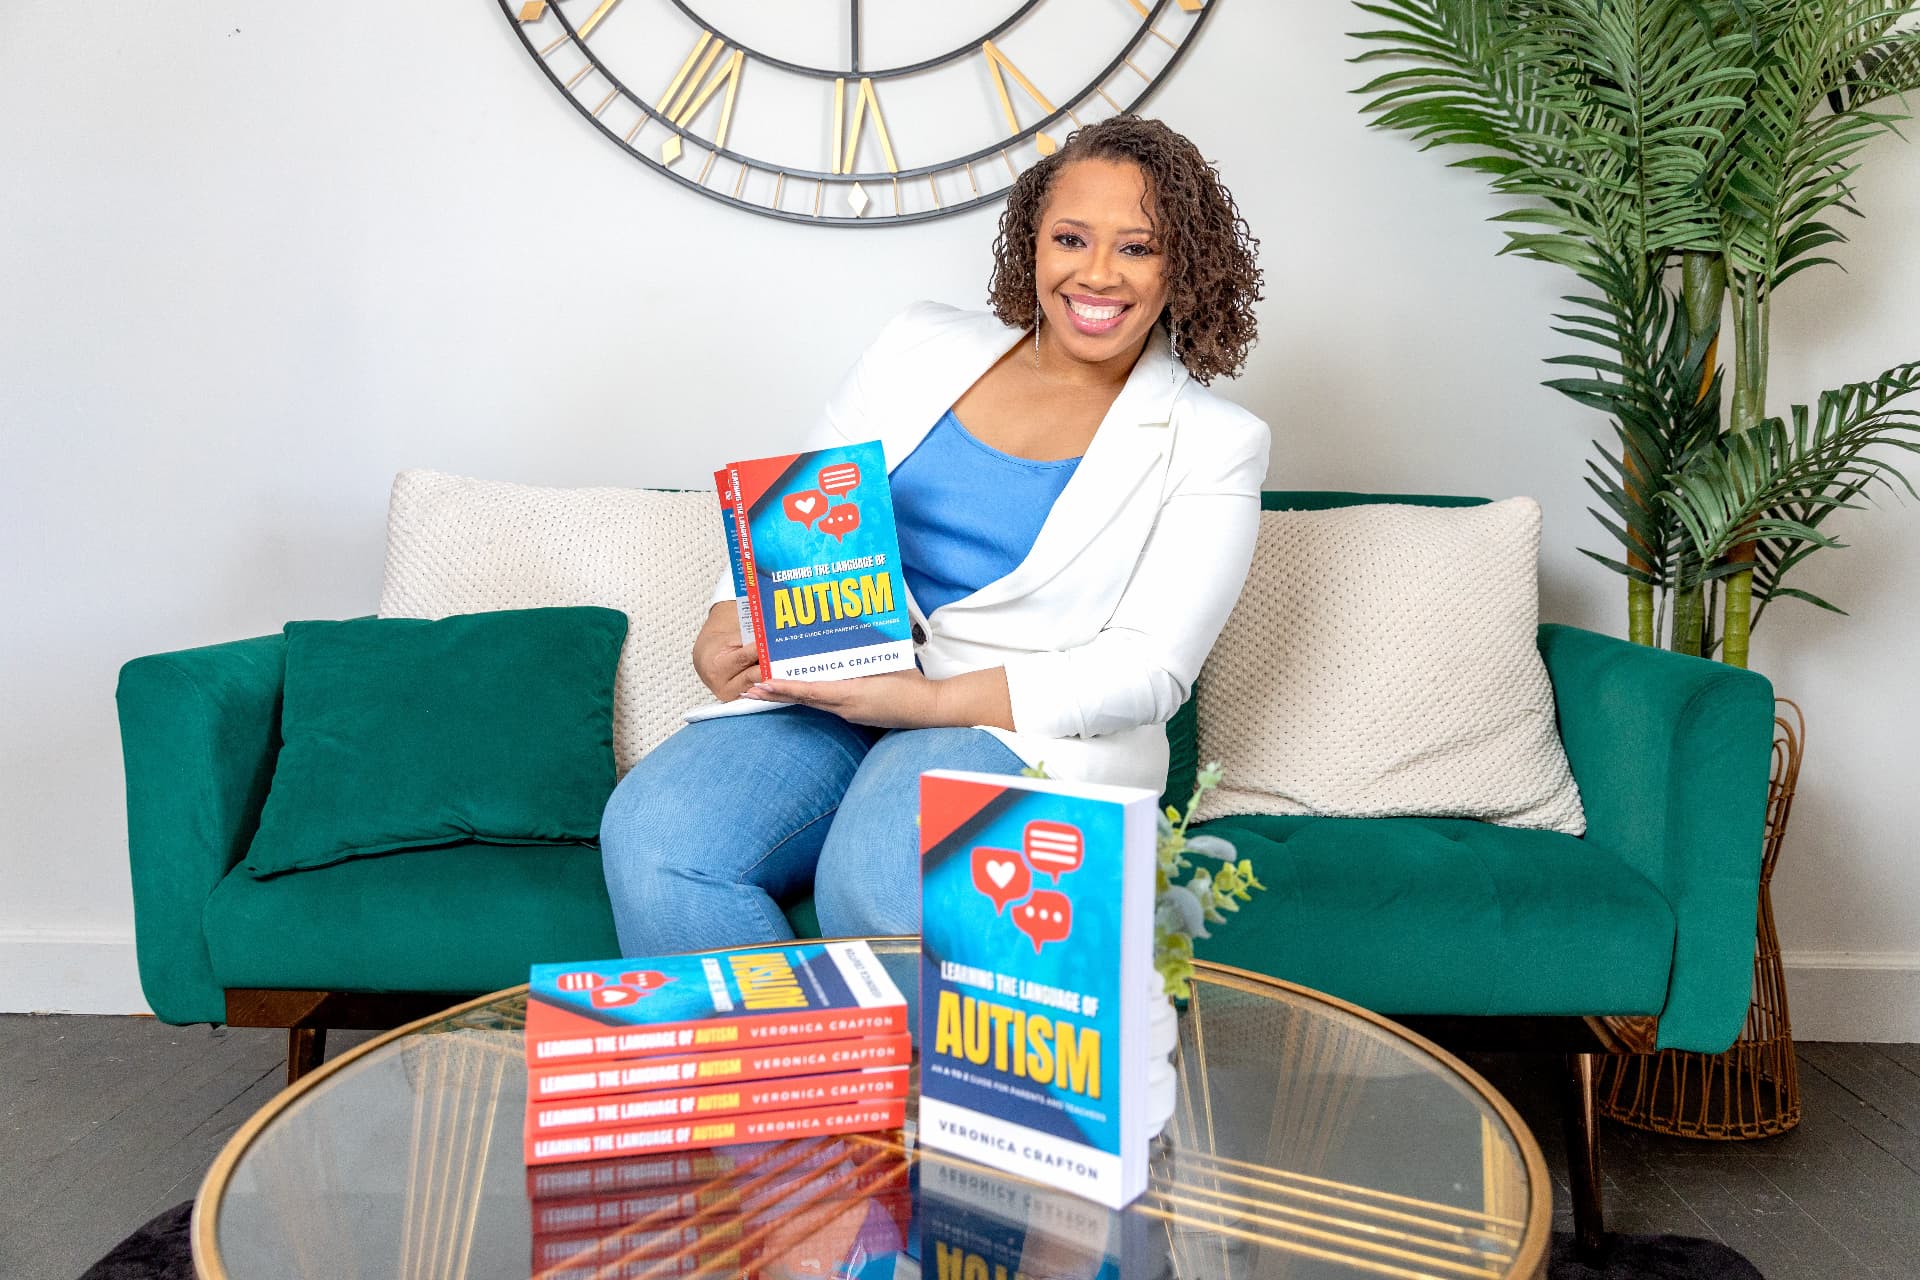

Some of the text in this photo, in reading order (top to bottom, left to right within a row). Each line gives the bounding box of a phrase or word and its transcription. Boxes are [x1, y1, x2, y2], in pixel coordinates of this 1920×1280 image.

[772, 554, 886, 582] LEARNING THE LANGUAGE OF
[774, 572, 895, 630] AUTISM
[804, 630, 821, 638] GUIDE
[834, 624, 859, 634] PARENTS
[859, 622, 872, 630] AND
[872, 618, 900, 627] TEACHERS
[786, 652, 899, 677] VERONICA CRAFTON
[728, 952, 809, 1010] AUTISM
[941, 960, 1099, 1018] LEARNING THE LANGUAGE OF
[537, 1016, 893, 1058] LEARNING THE LANGUAGE OF AUTISM VERONICA CRAFTON
[935, 989, 1101, 1099] AUTISM
[540, 1047, 896, 1094] LEARNING THE LANGUAGE OF AUTISM VERONICA CRAFTON
[539, 1081, 894, 1128] LEARNING THE LANGUAGE OF AUTISM VERONICA CRAFTON
[534, 1112, 890, 1158] LEARNING THE LANGUAGE OF AUTISM VERONICA CRAFTON
[938, 1119, 1099, 1179] VERONICA CRAFTON
